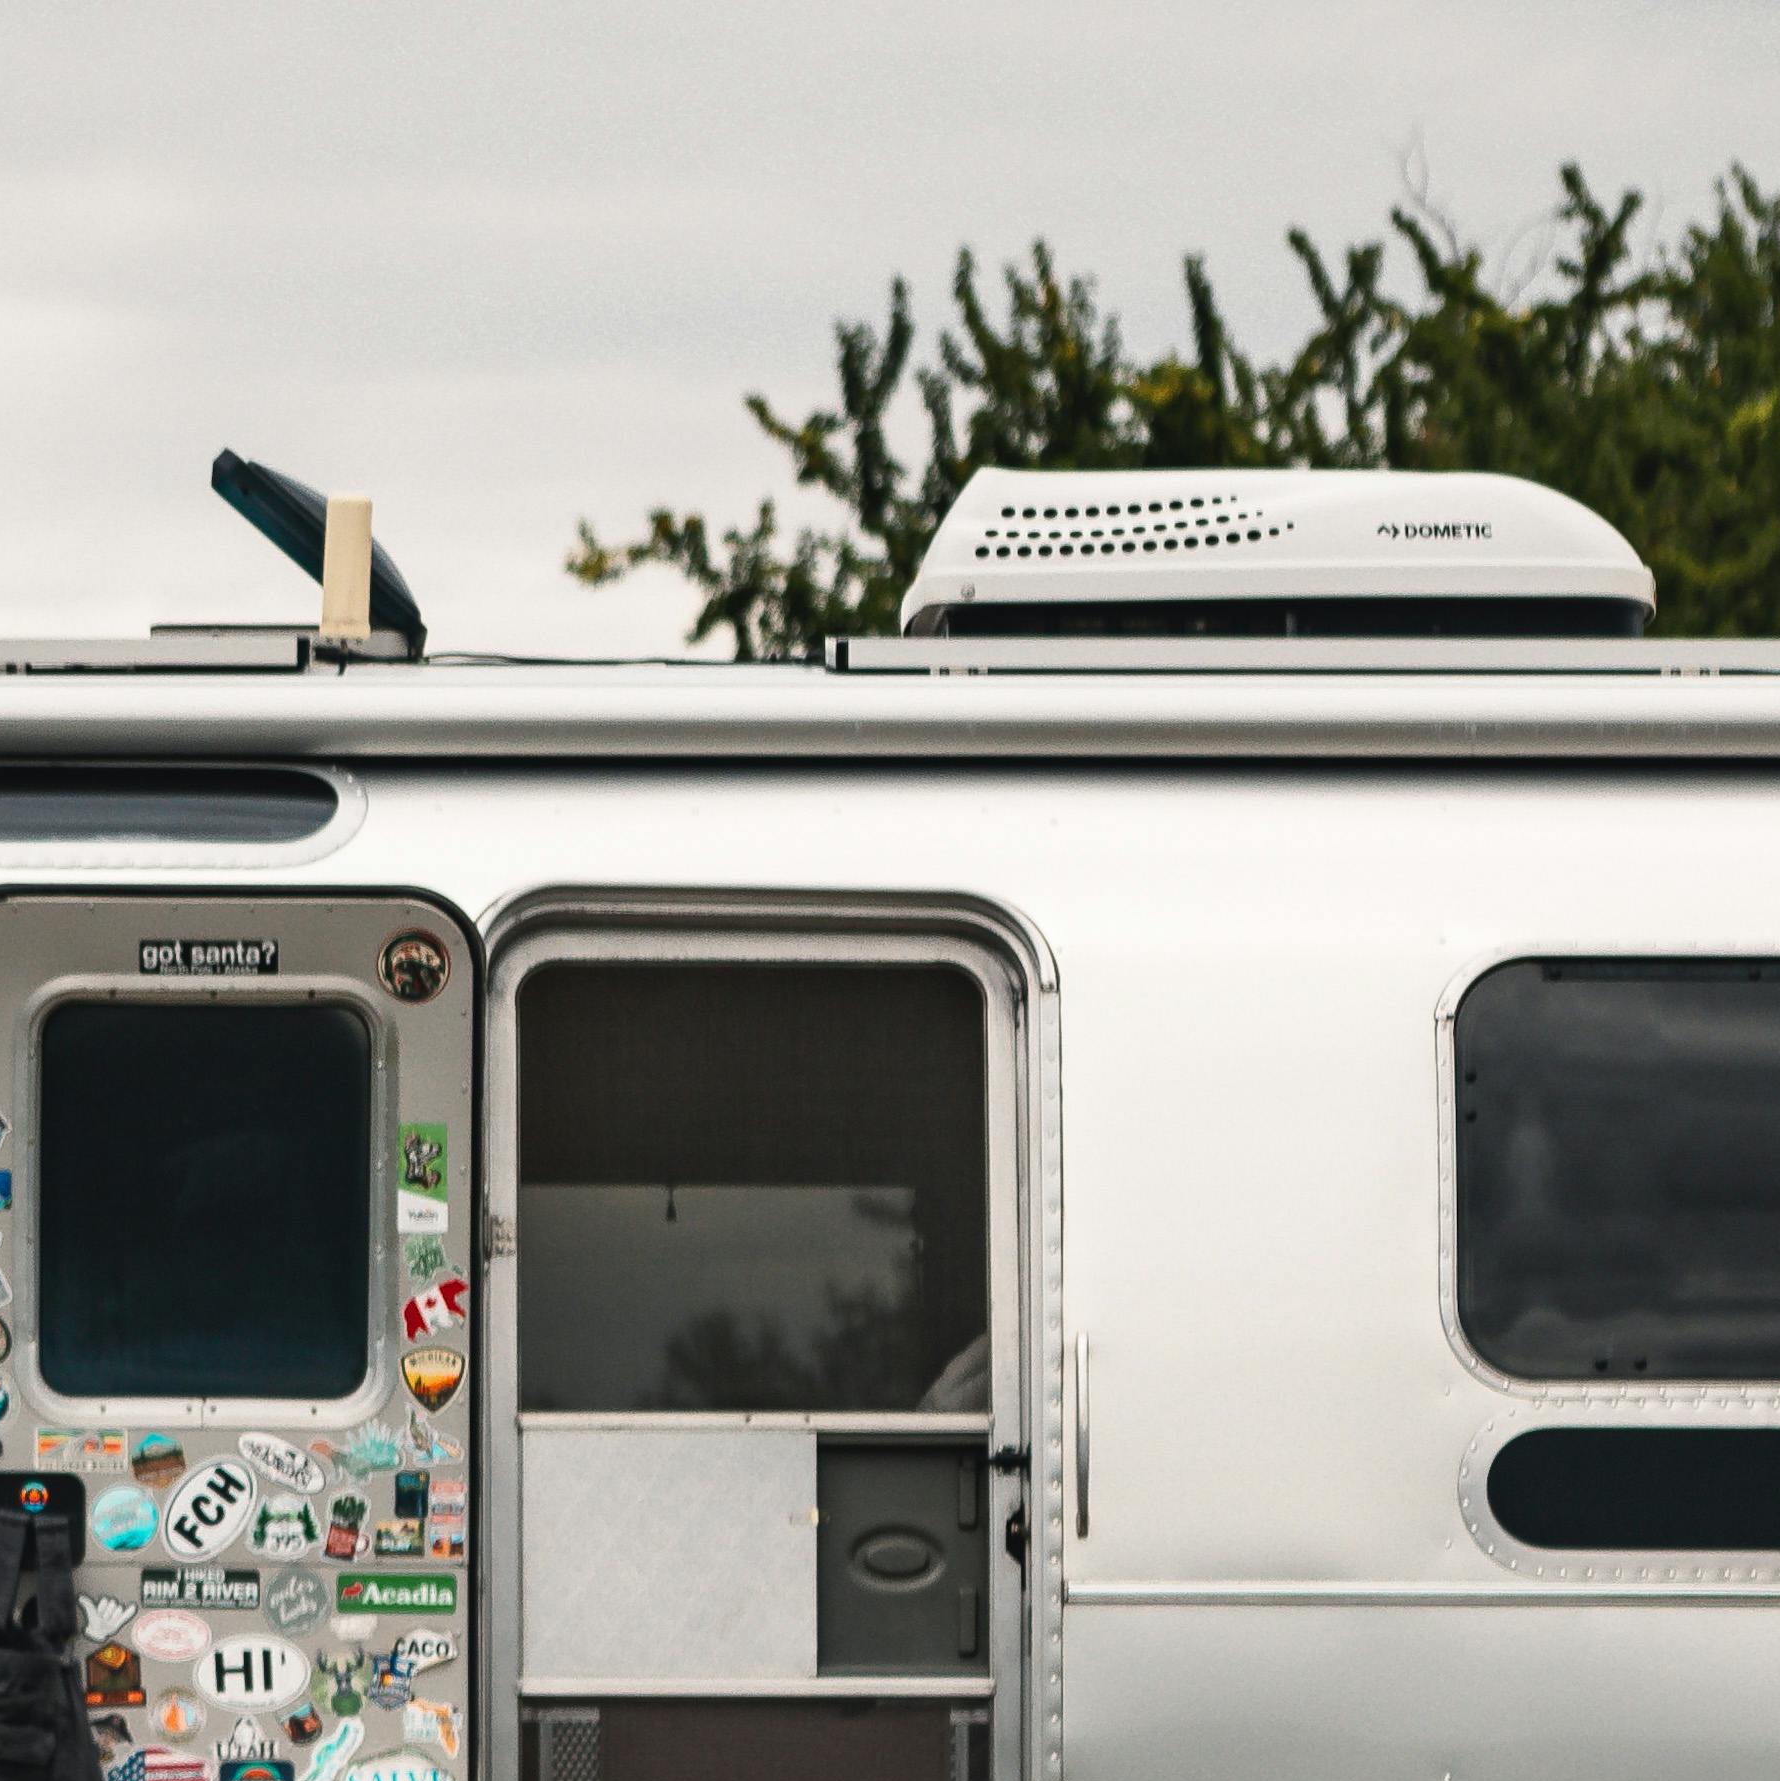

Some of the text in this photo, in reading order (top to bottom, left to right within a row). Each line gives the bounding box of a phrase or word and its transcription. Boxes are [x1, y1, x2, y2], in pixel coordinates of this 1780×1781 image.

[1405, 522, 1492, 539] DOMETIC
[142, 940, 276, 969] got santa?
[173, 1466, 246, 1548] FCH
[143, 1580, 179, 1599] RIM
[202, 1579, 258, 1599] RIVER
[362, 1581, 454, 1606] Acadia
[394, 1637, 451, 1657] CACO
